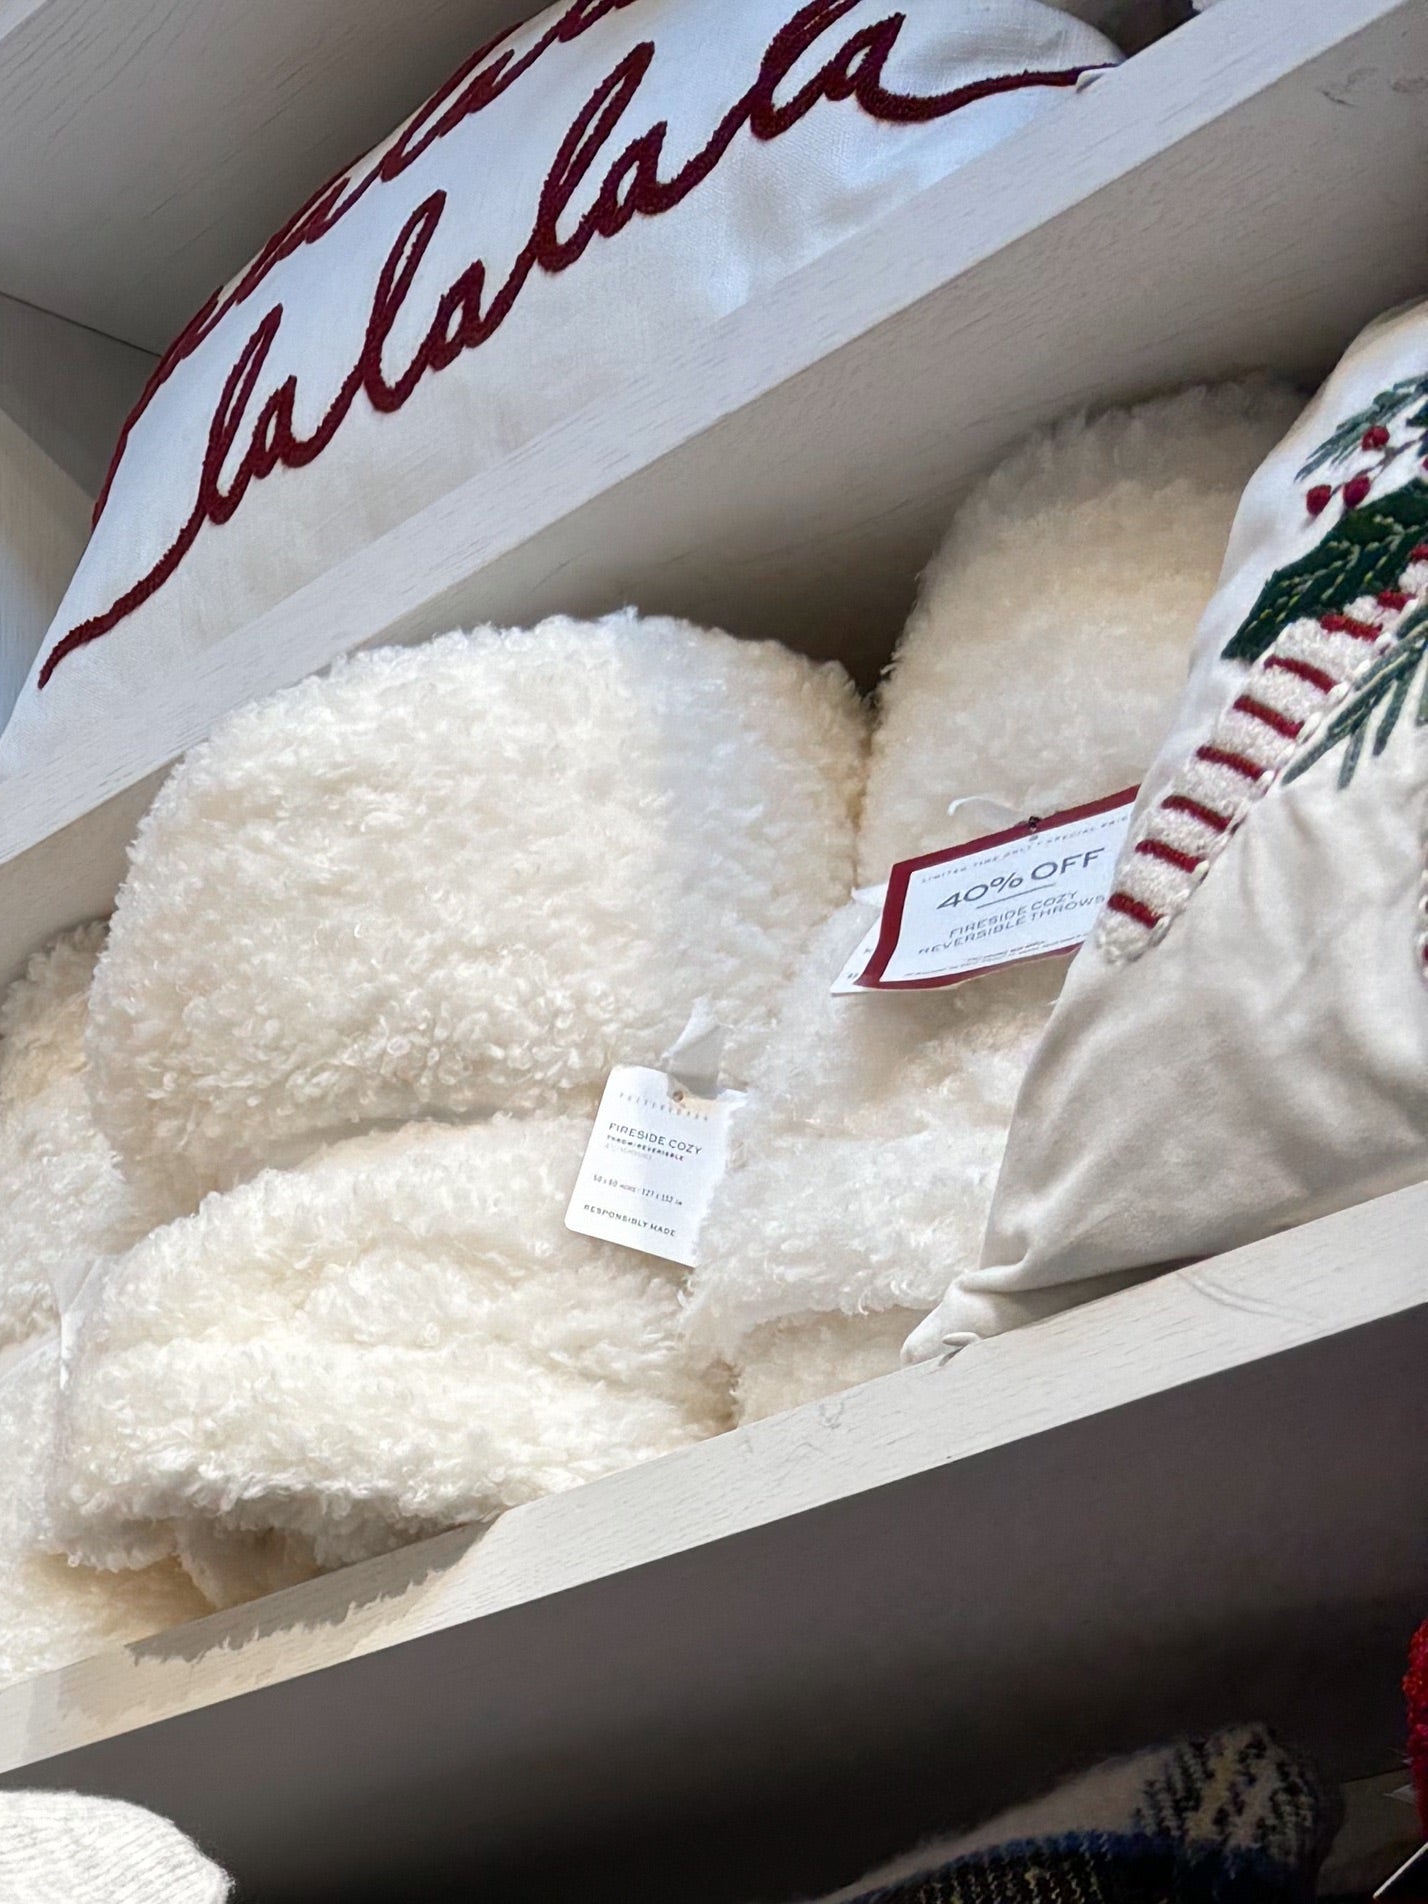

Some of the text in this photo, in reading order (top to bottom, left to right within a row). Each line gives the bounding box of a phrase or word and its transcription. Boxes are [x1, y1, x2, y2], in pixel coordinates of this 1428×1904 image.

[936, 847, 1106, 910] 40% OFF
[917, 894, 1106, 955] REVERSIBLE THROWS
[948, 890, 1079, 939] FIRESIDE COZY
[608, 1122, 666, 1146] FIRESIDE
[668, 1139, 703, 1155] COZY
[583, 1204, 677, 1237] RESPONSIBLY MADE
